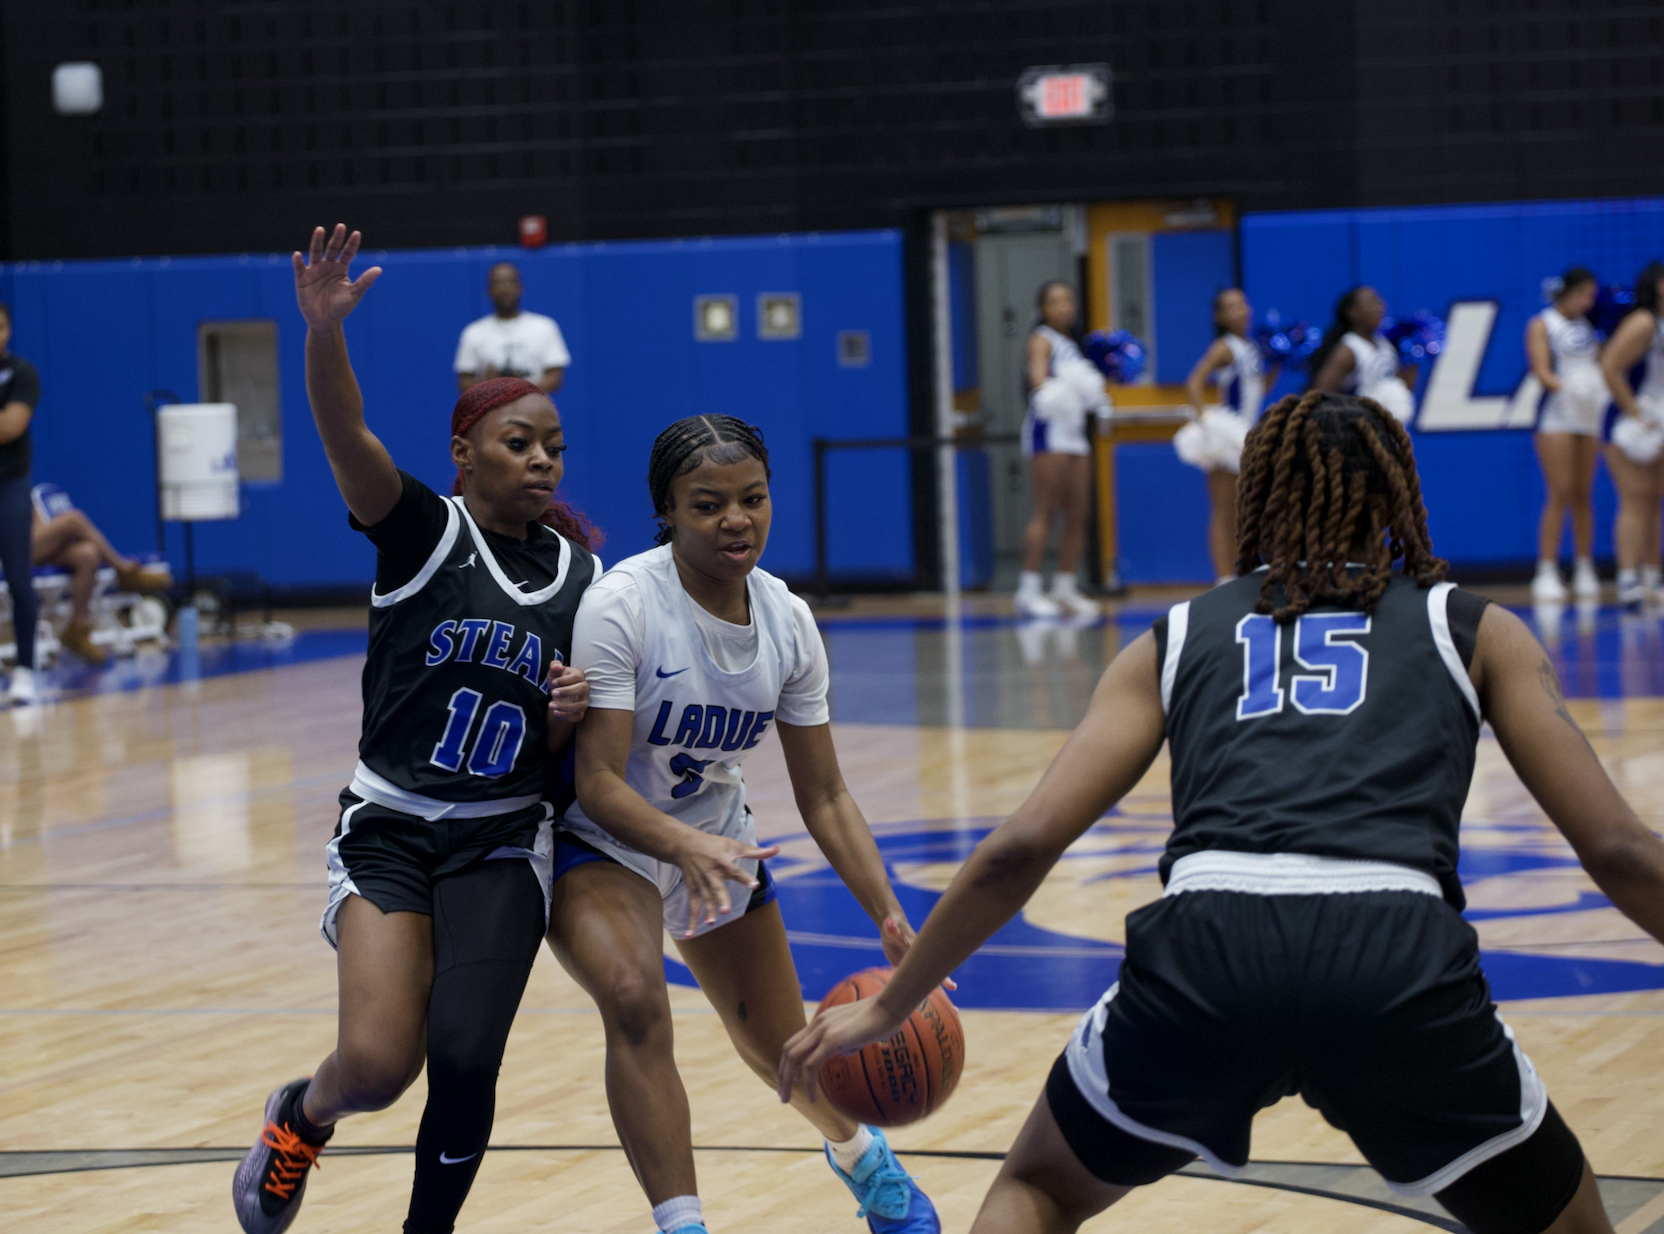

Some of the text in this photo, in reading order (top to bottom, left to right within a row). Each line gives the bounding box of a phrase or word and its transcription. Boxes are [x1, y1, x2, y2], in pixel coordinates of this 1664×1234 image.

[1235, 612, 1372, 721] 15
[429, 686, 527, 780] 10
[646, 699, 775, 752] LADUE
[889, 1030, 918, 1106] EGACY
